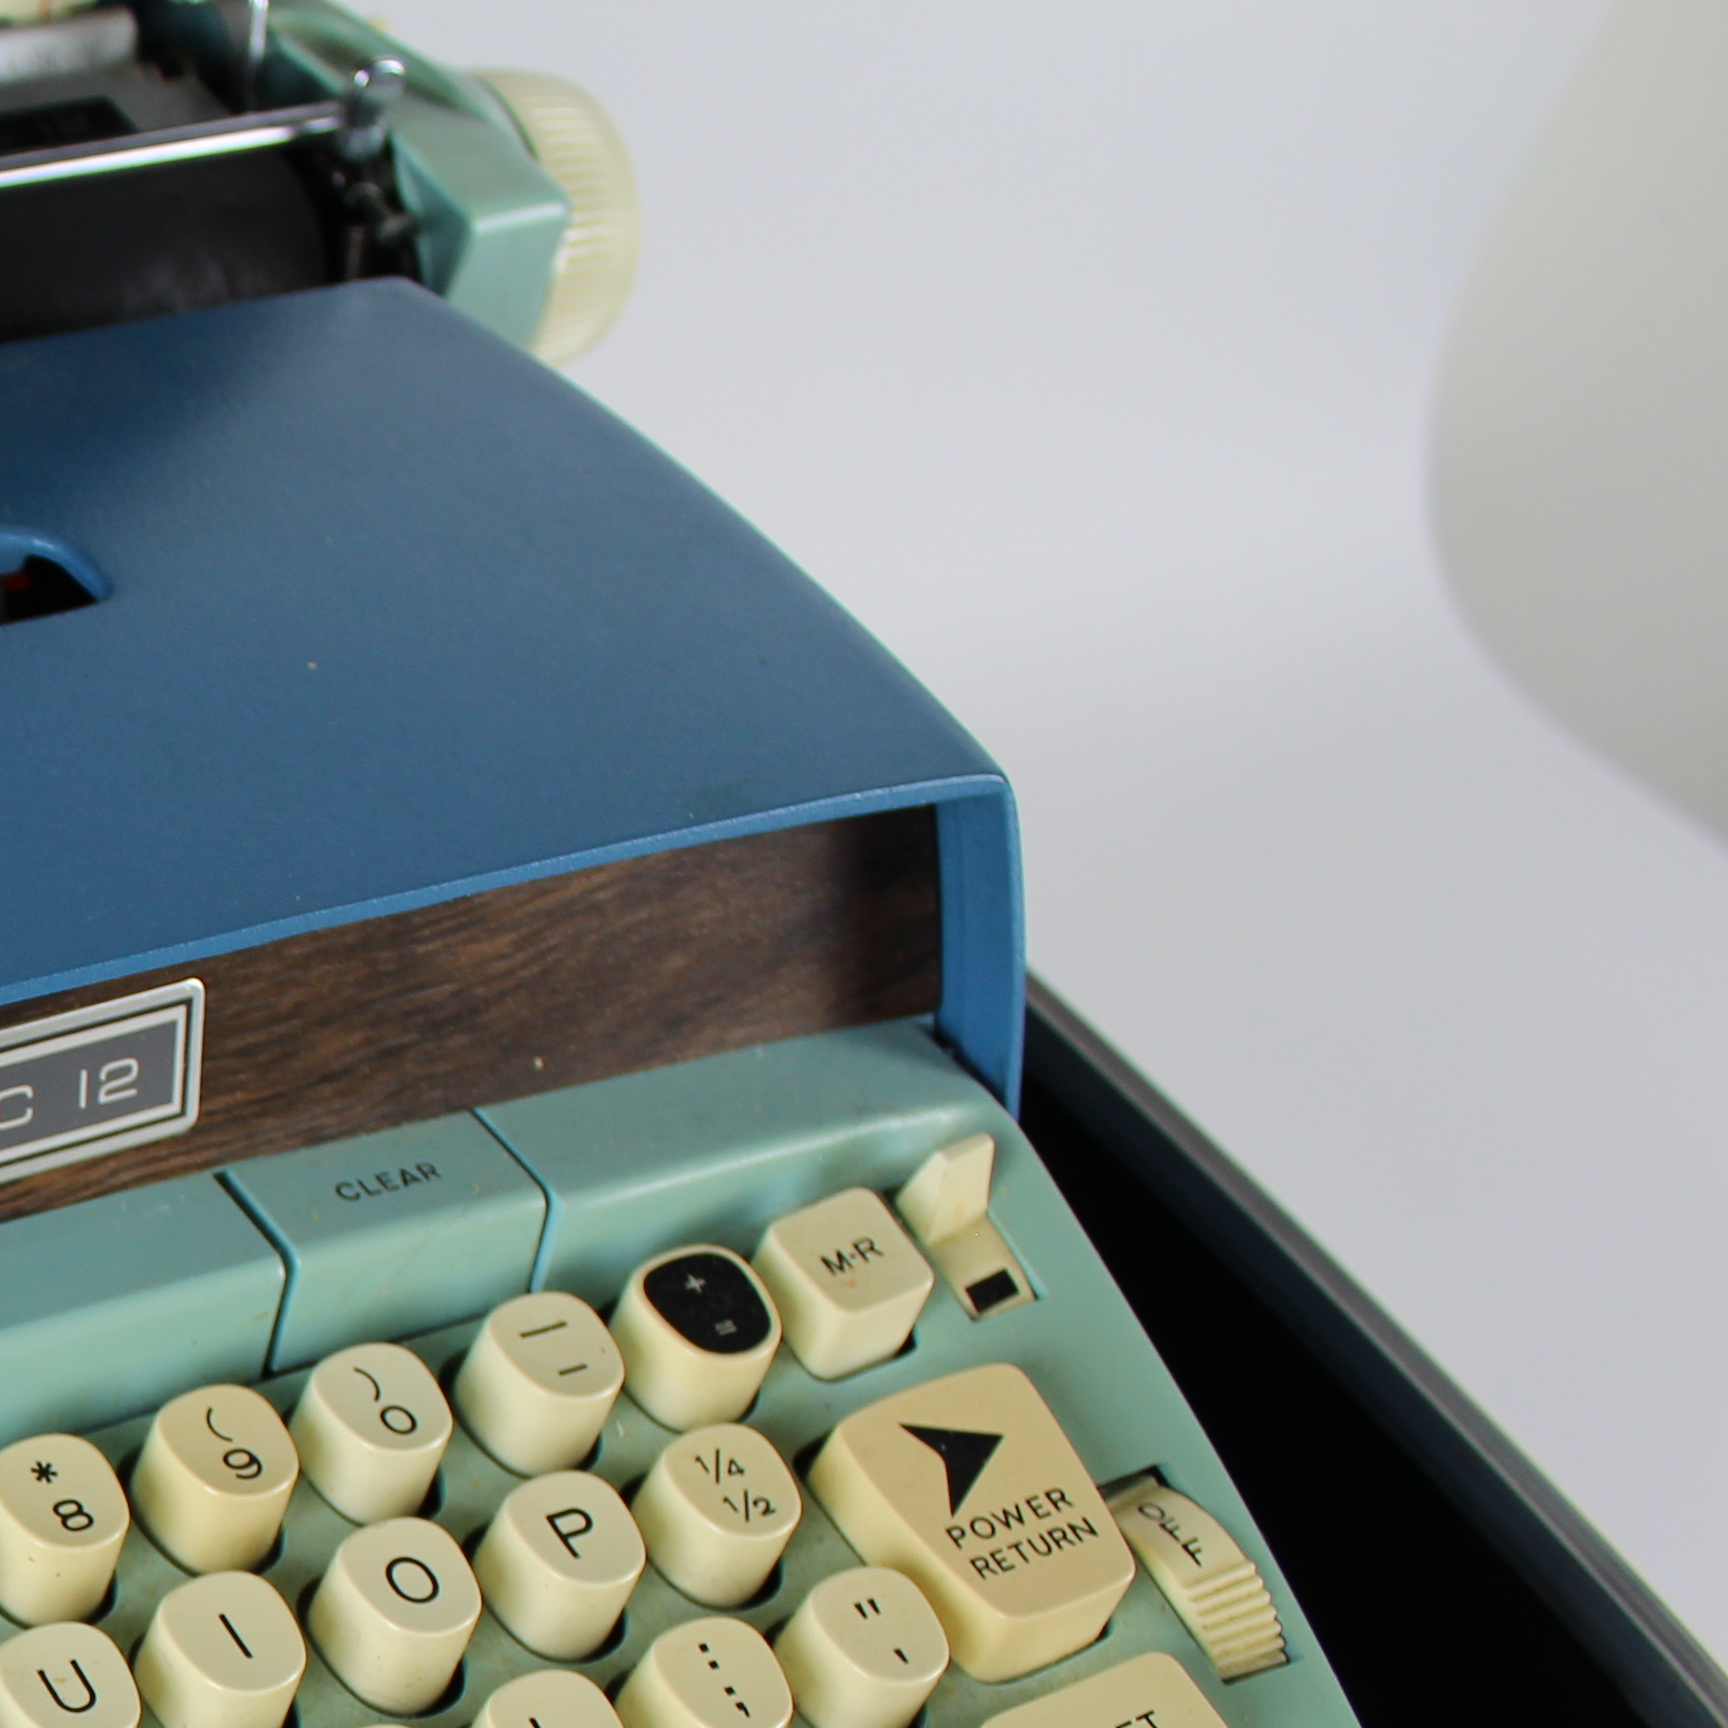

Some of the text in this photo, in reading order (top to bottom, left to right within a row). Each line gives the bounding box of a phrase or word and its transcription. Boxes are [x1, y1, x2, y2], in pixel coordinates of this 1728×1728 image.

[79, 1058, 139, 1109] 12
[335, 1163, 440, 1201] CLEAR
[222, 1448, 263, 1480] 9
[52, 1499, 94, 1532] 8
[545, 1508, 593, 1559] P
[945, 1486, 1074, 1550] POWER
[1138, 1502, 1202, 1567] OFF
[971, 1517, 1098, 1582] RETURN
[385, 1556, 440, 1604] O
[218, 1613, 253, 1659] I
[37, 1659, 97, 1714] U
